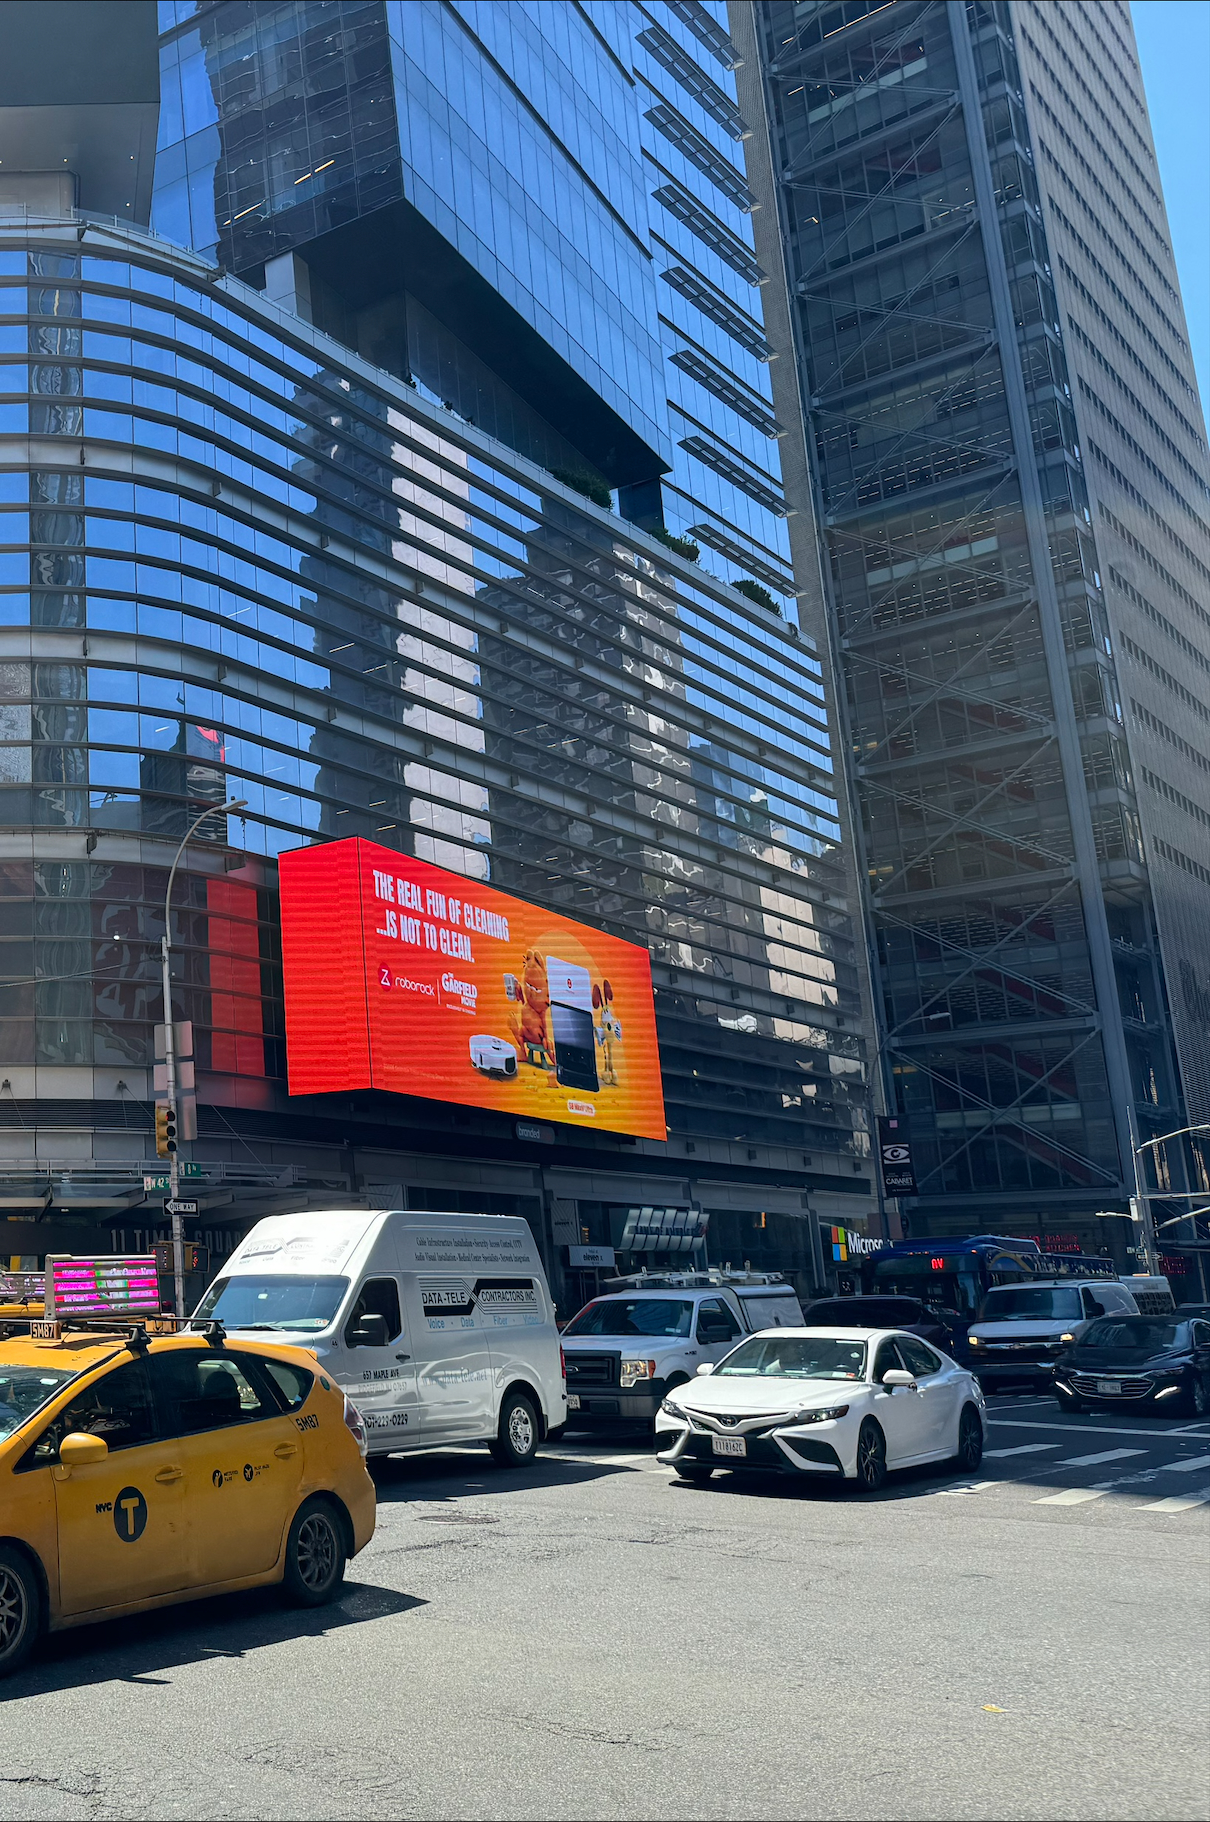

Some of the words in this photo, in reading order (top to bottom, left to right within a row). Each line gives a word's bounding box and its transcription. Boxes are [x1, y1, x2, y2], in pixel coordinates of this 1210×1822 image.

[373, 869, 395, 903] THE
[396, 878, 424, 913] REAL
[426, 888, 447, 921] FUN
[448, 897, 461, 925] OF
[463, 902, 510, 942] CLEANING
[400, 914, 421, 947] NOT
[423, 922, 438, 951] TO
[440, 928, 475, 963] CLEAN.
[394, 976, 435, 996] roborock
[441, 973, 478, 998] GARFIELD
[157, 1177, 165, 1188] 42
[169, 1202, 181, 1211] ONE
[183, 1202, 195, 1211] WAY
[111, 1229, 126, 1252] 11
[427, 1237, 453, 1247] Infrastructure
[847, 1232, 894, 1254] Microso
[425, 1252, 436, 1262] Visual
[421, 1292, 466, 1305] DATA-TELE
[481, 1290, 524, 1302] CONTRACTORS
[525, 1291, 537, 1301] INC.
[427, 1318, 445, 1329] Voice
[460, 1317, 475, 1328] Data
[493, 1315, 508, 1325] Fiber
[32, 1323, 55, 1339] 5M87
[362, 1370, 372, 1380] 657
[373, 1369, 389, 1379] MAPLE
[390, 1368, 400, 1378] AVE
[295, 1414, 320, 1431] 5M87
[95, 1502, 112, 1514] NYC
[120, 1496, 140, 1536] T
